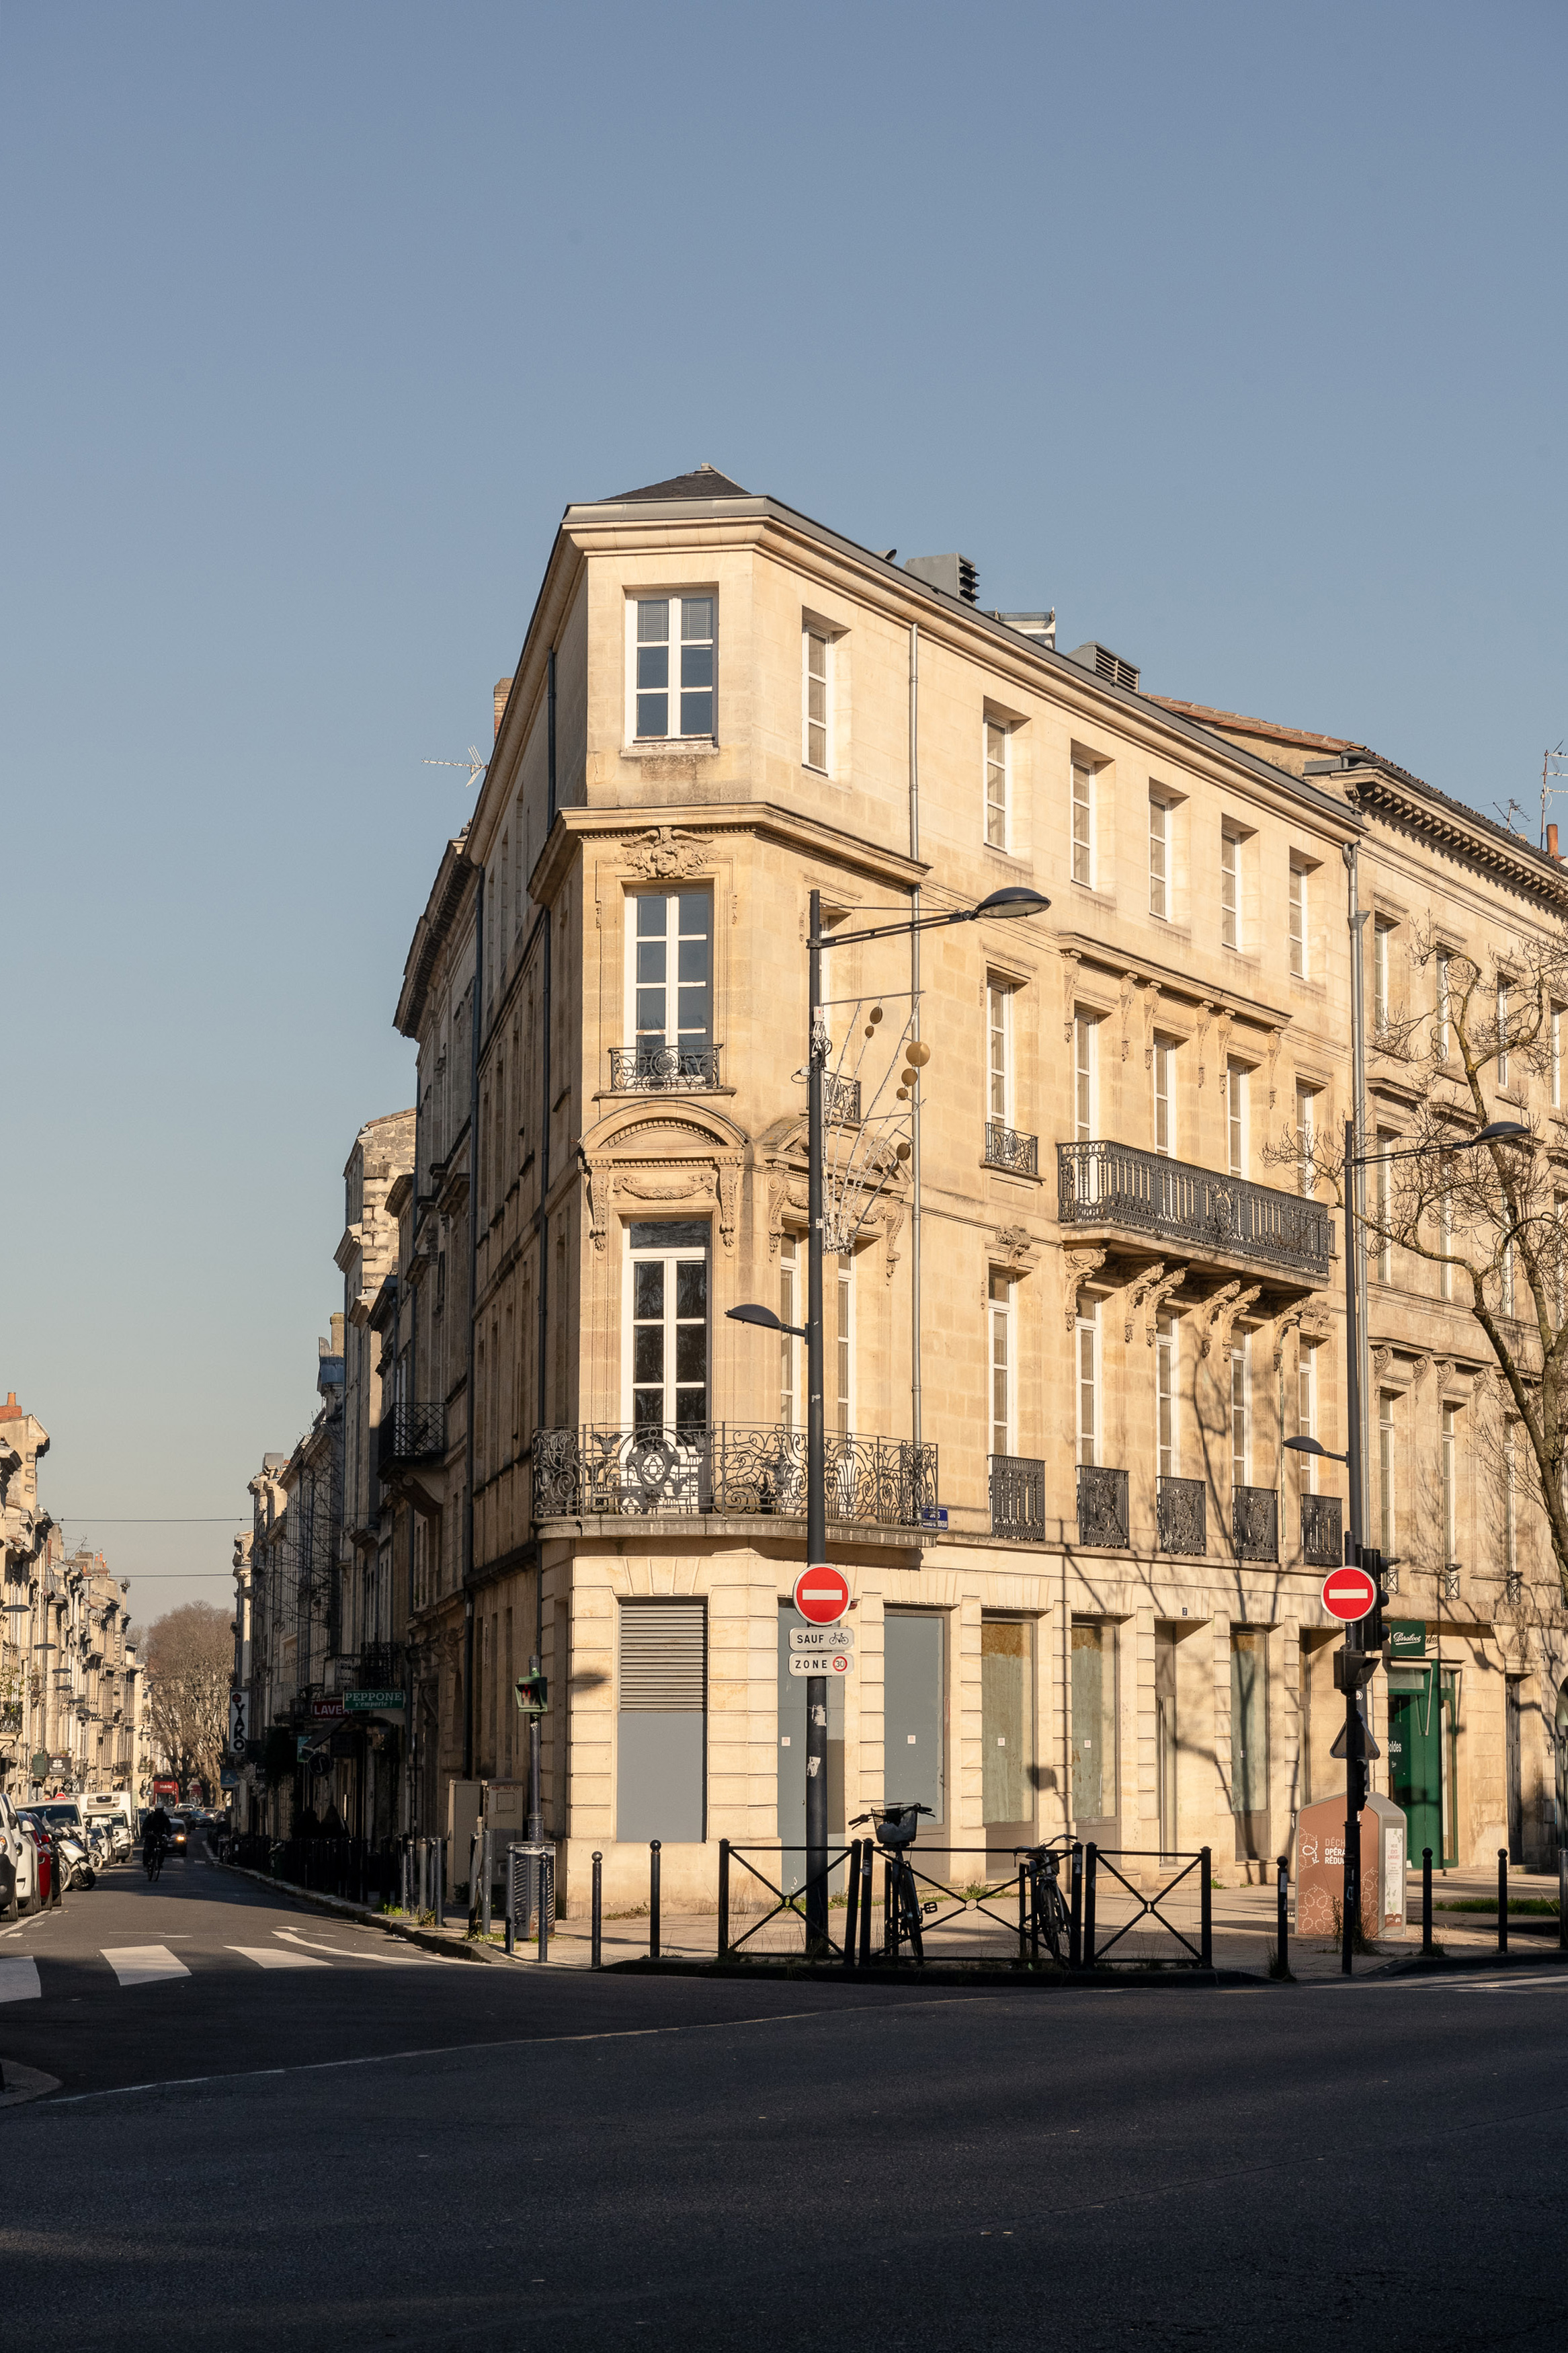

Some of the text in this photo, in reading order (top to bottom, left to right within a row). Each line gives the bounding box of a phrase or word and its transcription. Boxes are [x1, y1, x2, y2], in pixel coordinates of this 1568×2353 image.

[796, 1634, 824, 1644] SAUF
[795, 1660, 845, 1669] ZONE 30
[345, 1692, 402, 1702] PEPPONE
[233, 1704, 245, 1751] YAKO
[1388, 1741, 1402, 1753] oldes
